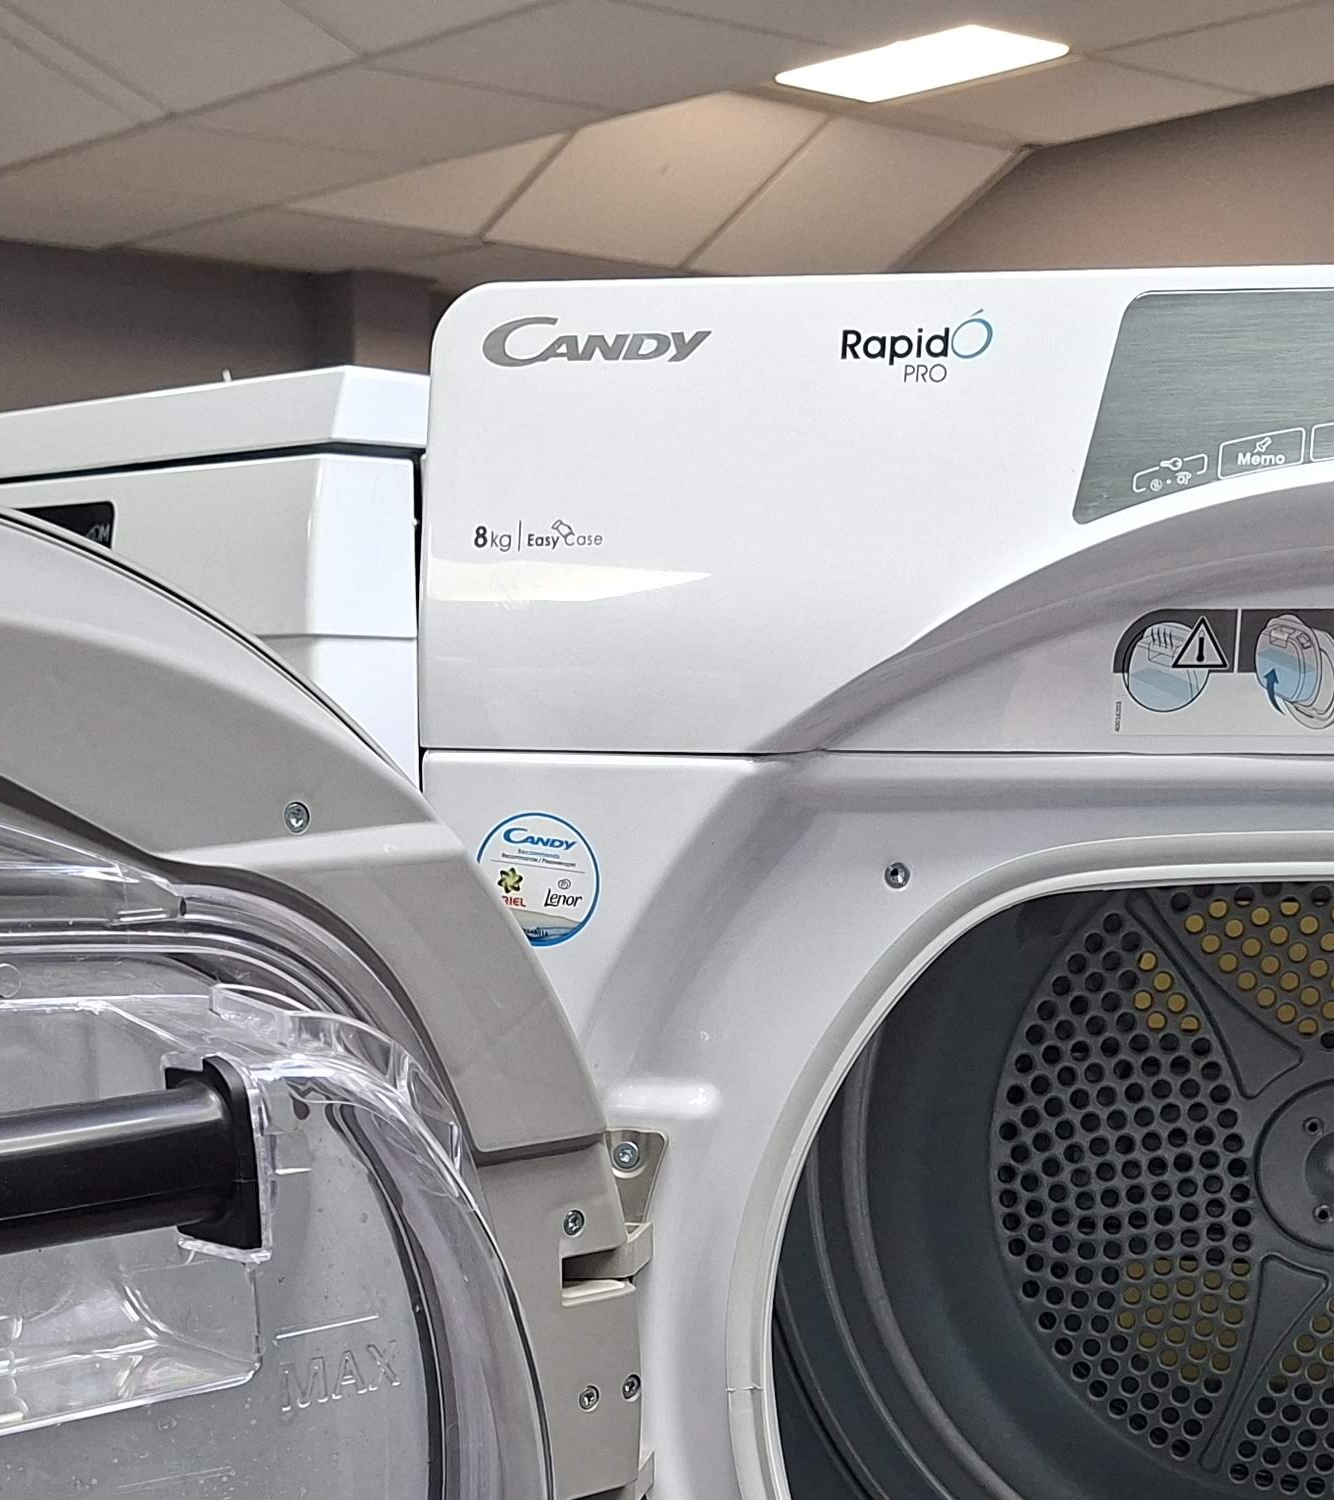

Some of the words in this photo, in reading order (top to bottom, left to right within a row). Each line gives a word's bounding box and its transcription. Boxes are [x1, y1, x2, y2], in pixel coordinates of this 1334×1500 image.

[482, 316, 712, 367] CANDY
[903, 364, 947, 383] PRO
[1237, 452, 1285, 466] Memo
[503, 827, 577, 850] CANDY
[502, 895, 526, 907] RIEL
[544, 888, 582, 907] Lenor
[279, 1340, 402, 1412] MAX
